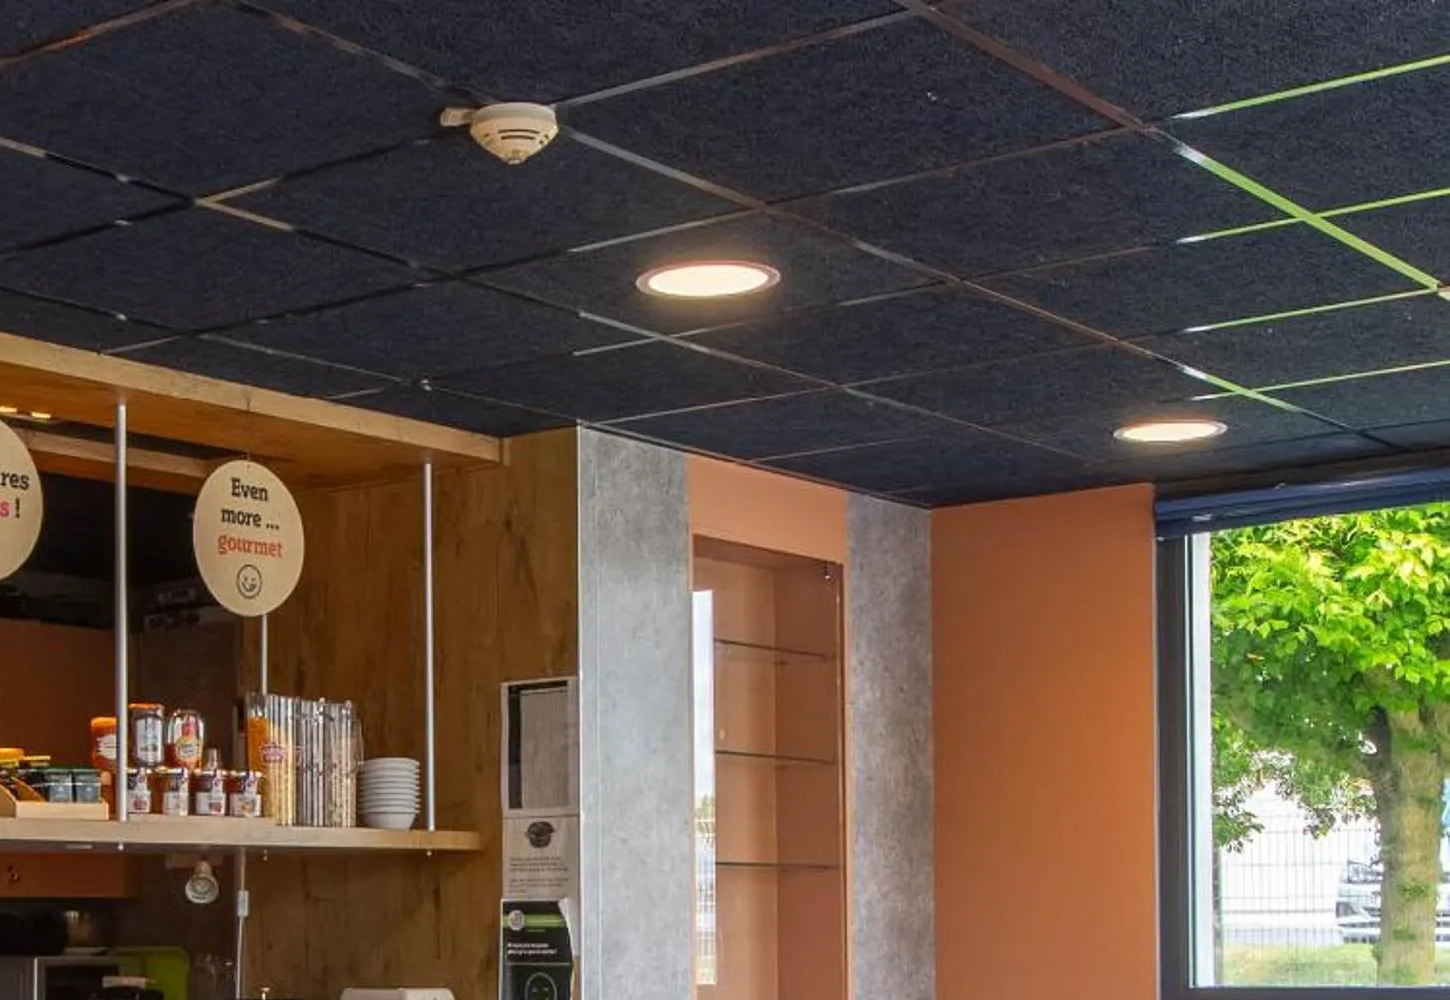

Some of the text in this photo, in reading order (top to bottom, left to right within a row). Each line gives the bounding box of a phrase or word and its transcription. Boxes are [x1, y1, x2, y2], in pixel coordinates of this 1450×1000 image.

[231, 477, 269, 502] Even
[220, 507, 262, 529] more
[217, 533, 284, 558] gourmet
